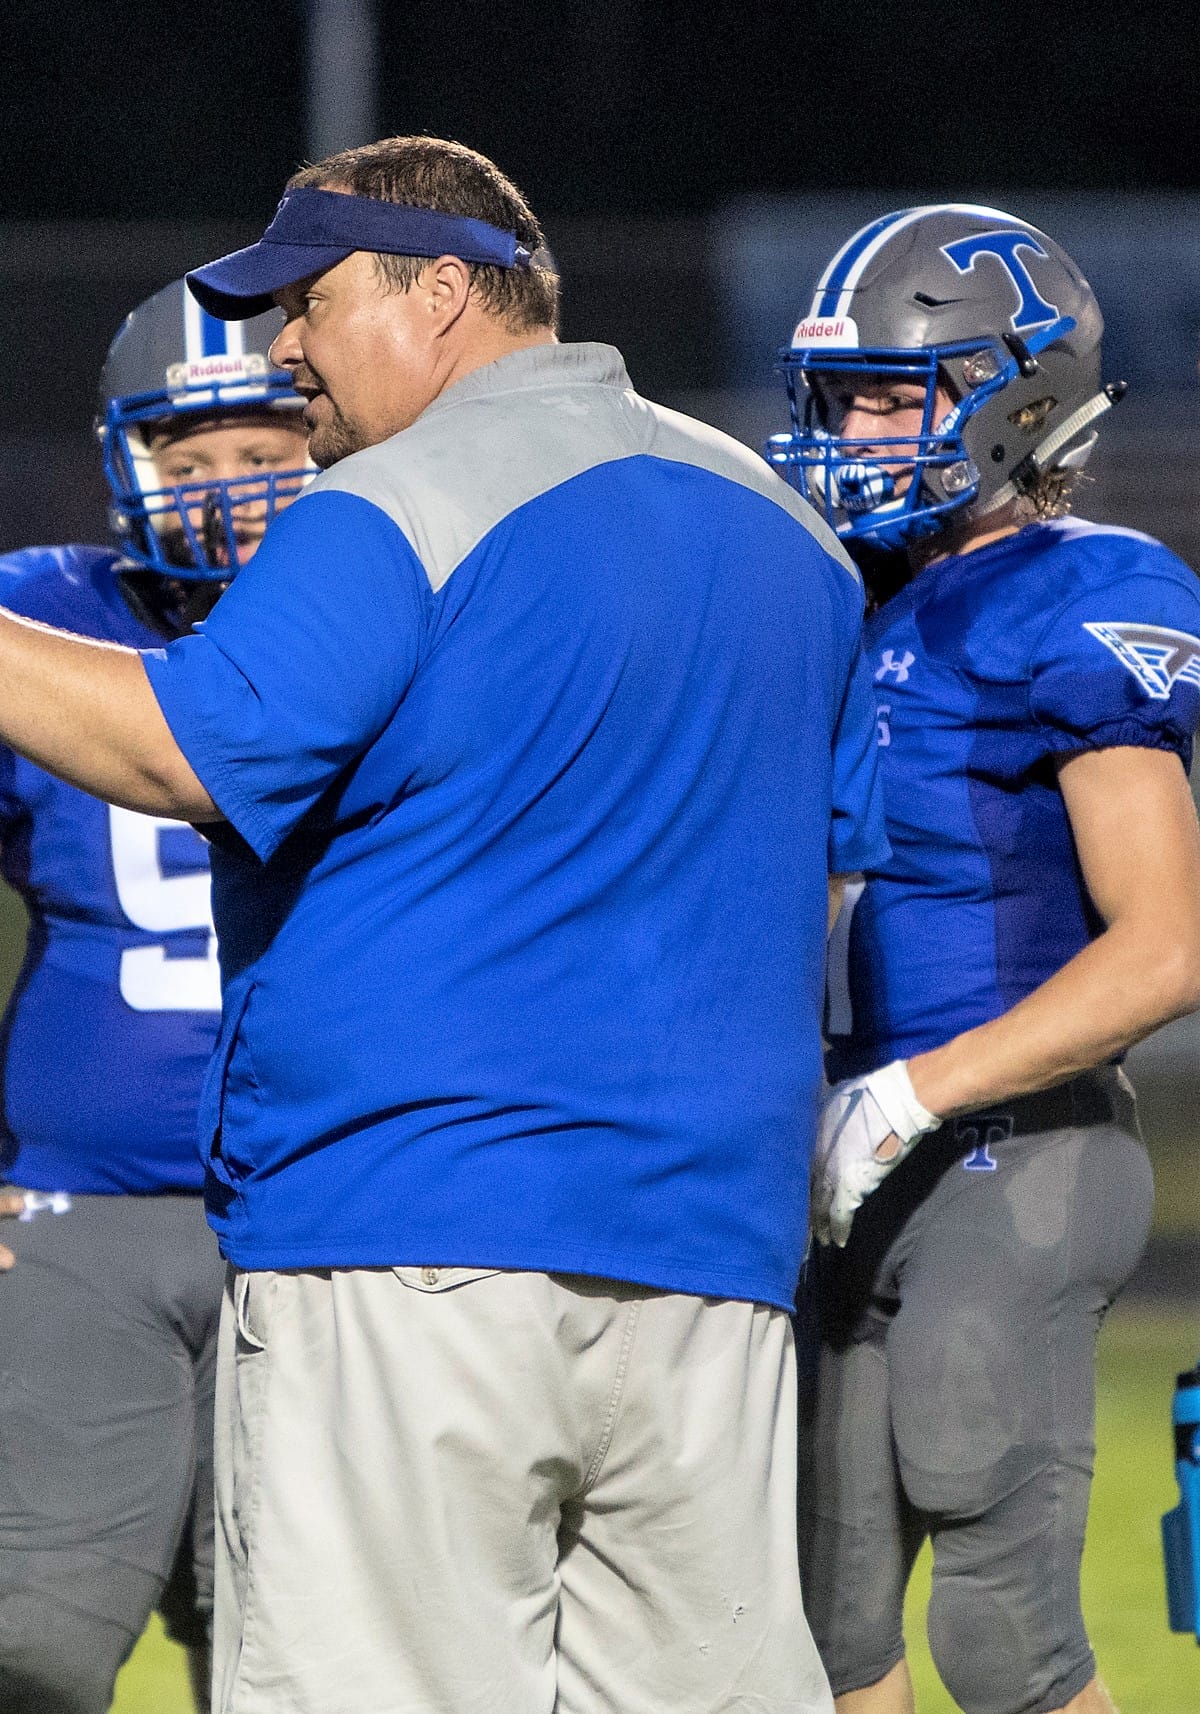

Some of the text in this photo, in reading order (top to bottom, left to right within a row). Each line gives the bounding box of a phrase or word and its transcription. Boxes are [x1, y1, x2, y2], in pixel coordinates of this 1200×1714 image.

[939, 229, 1063, 333] T
[796, 322, 845, 338] Riddell
[189, 360, 243, 377] Riddell
[953, 1116, 1015, 1171] T
